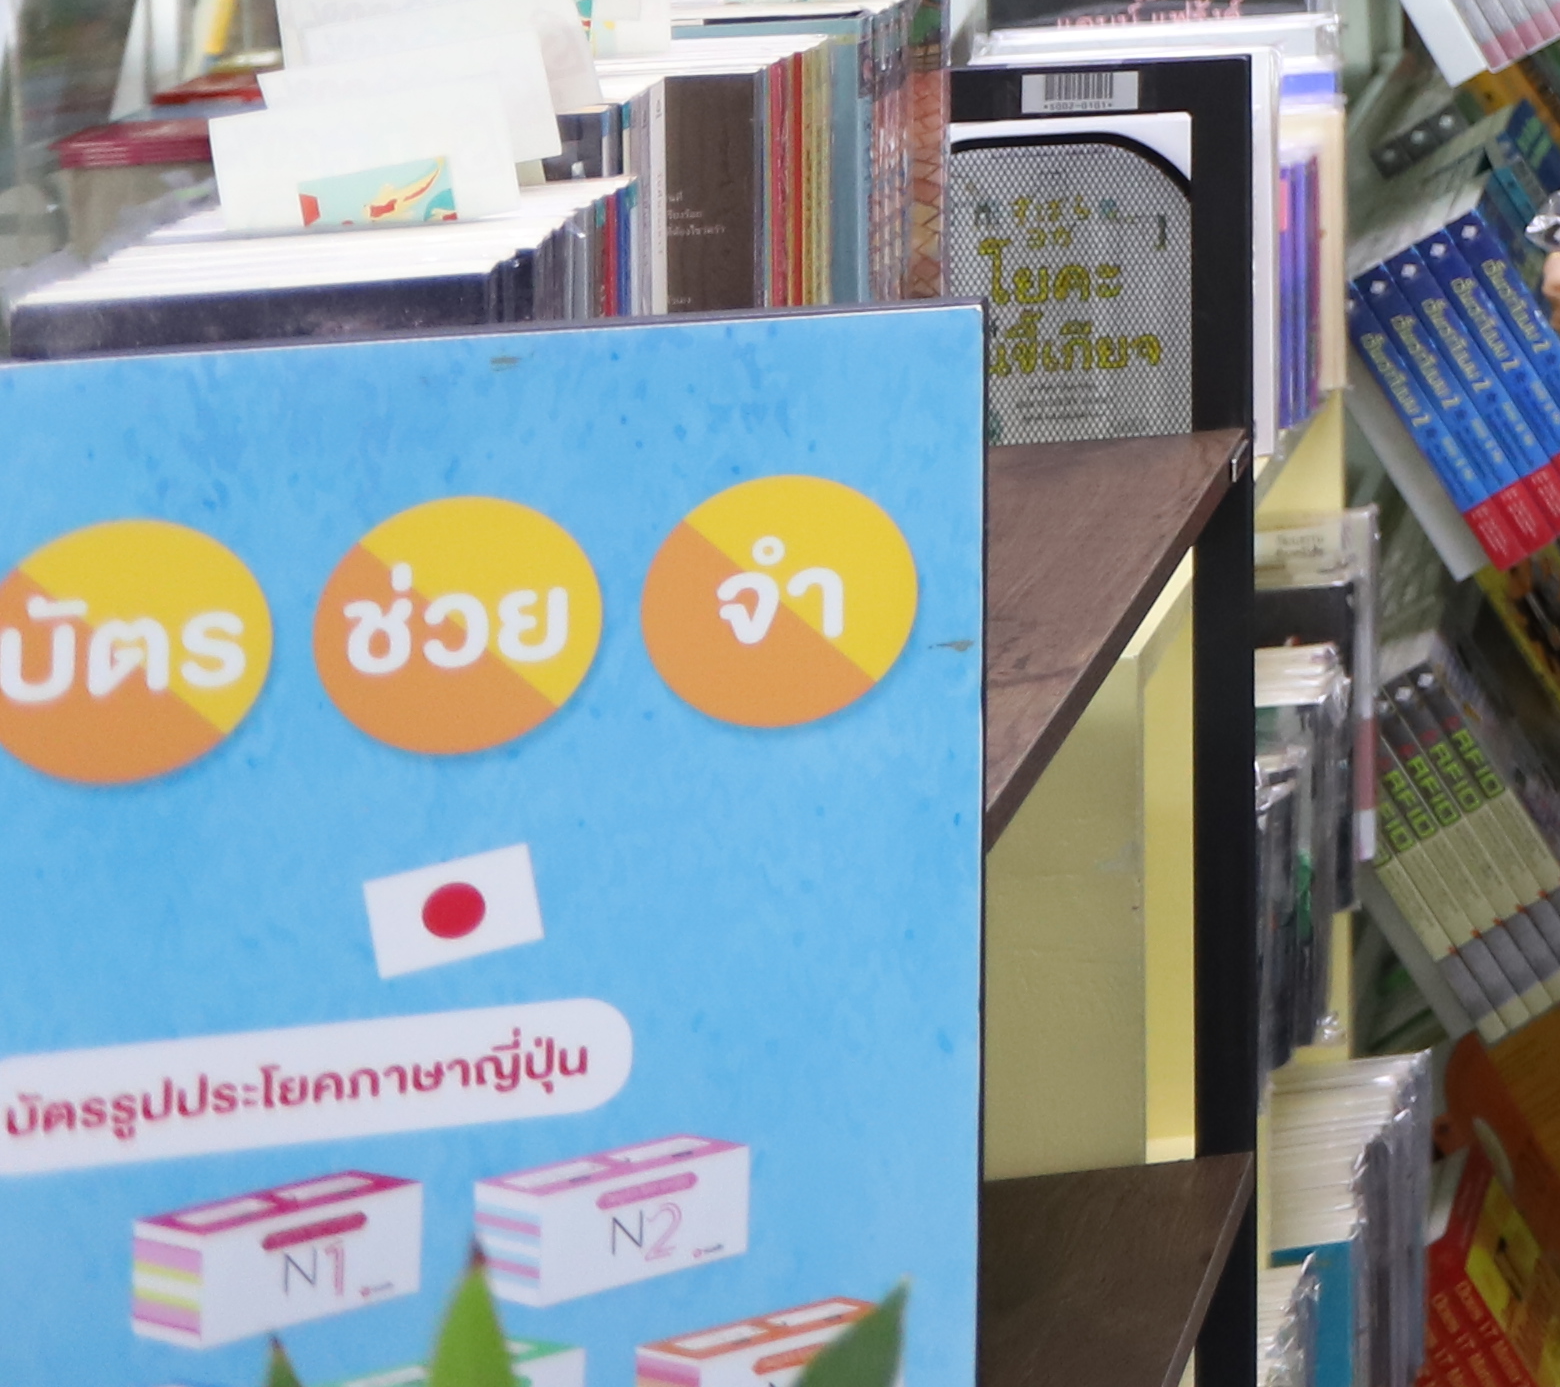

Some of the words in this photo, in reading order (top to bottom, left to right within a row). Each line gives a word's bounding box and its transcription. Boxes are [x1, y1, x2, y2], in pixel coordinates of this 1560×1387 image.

[2, 596, 248, 704] บัตร
[344, 562, 571, 677] ช่วย
[715, 534, 846, 646] จำ
[5, 1027, 591, 1142] บัตรรูปประโยคภาษาญี่ปุ่น
[281, 1235, 348, 1300] N1
[609, 1203, 686, 1263] N2
